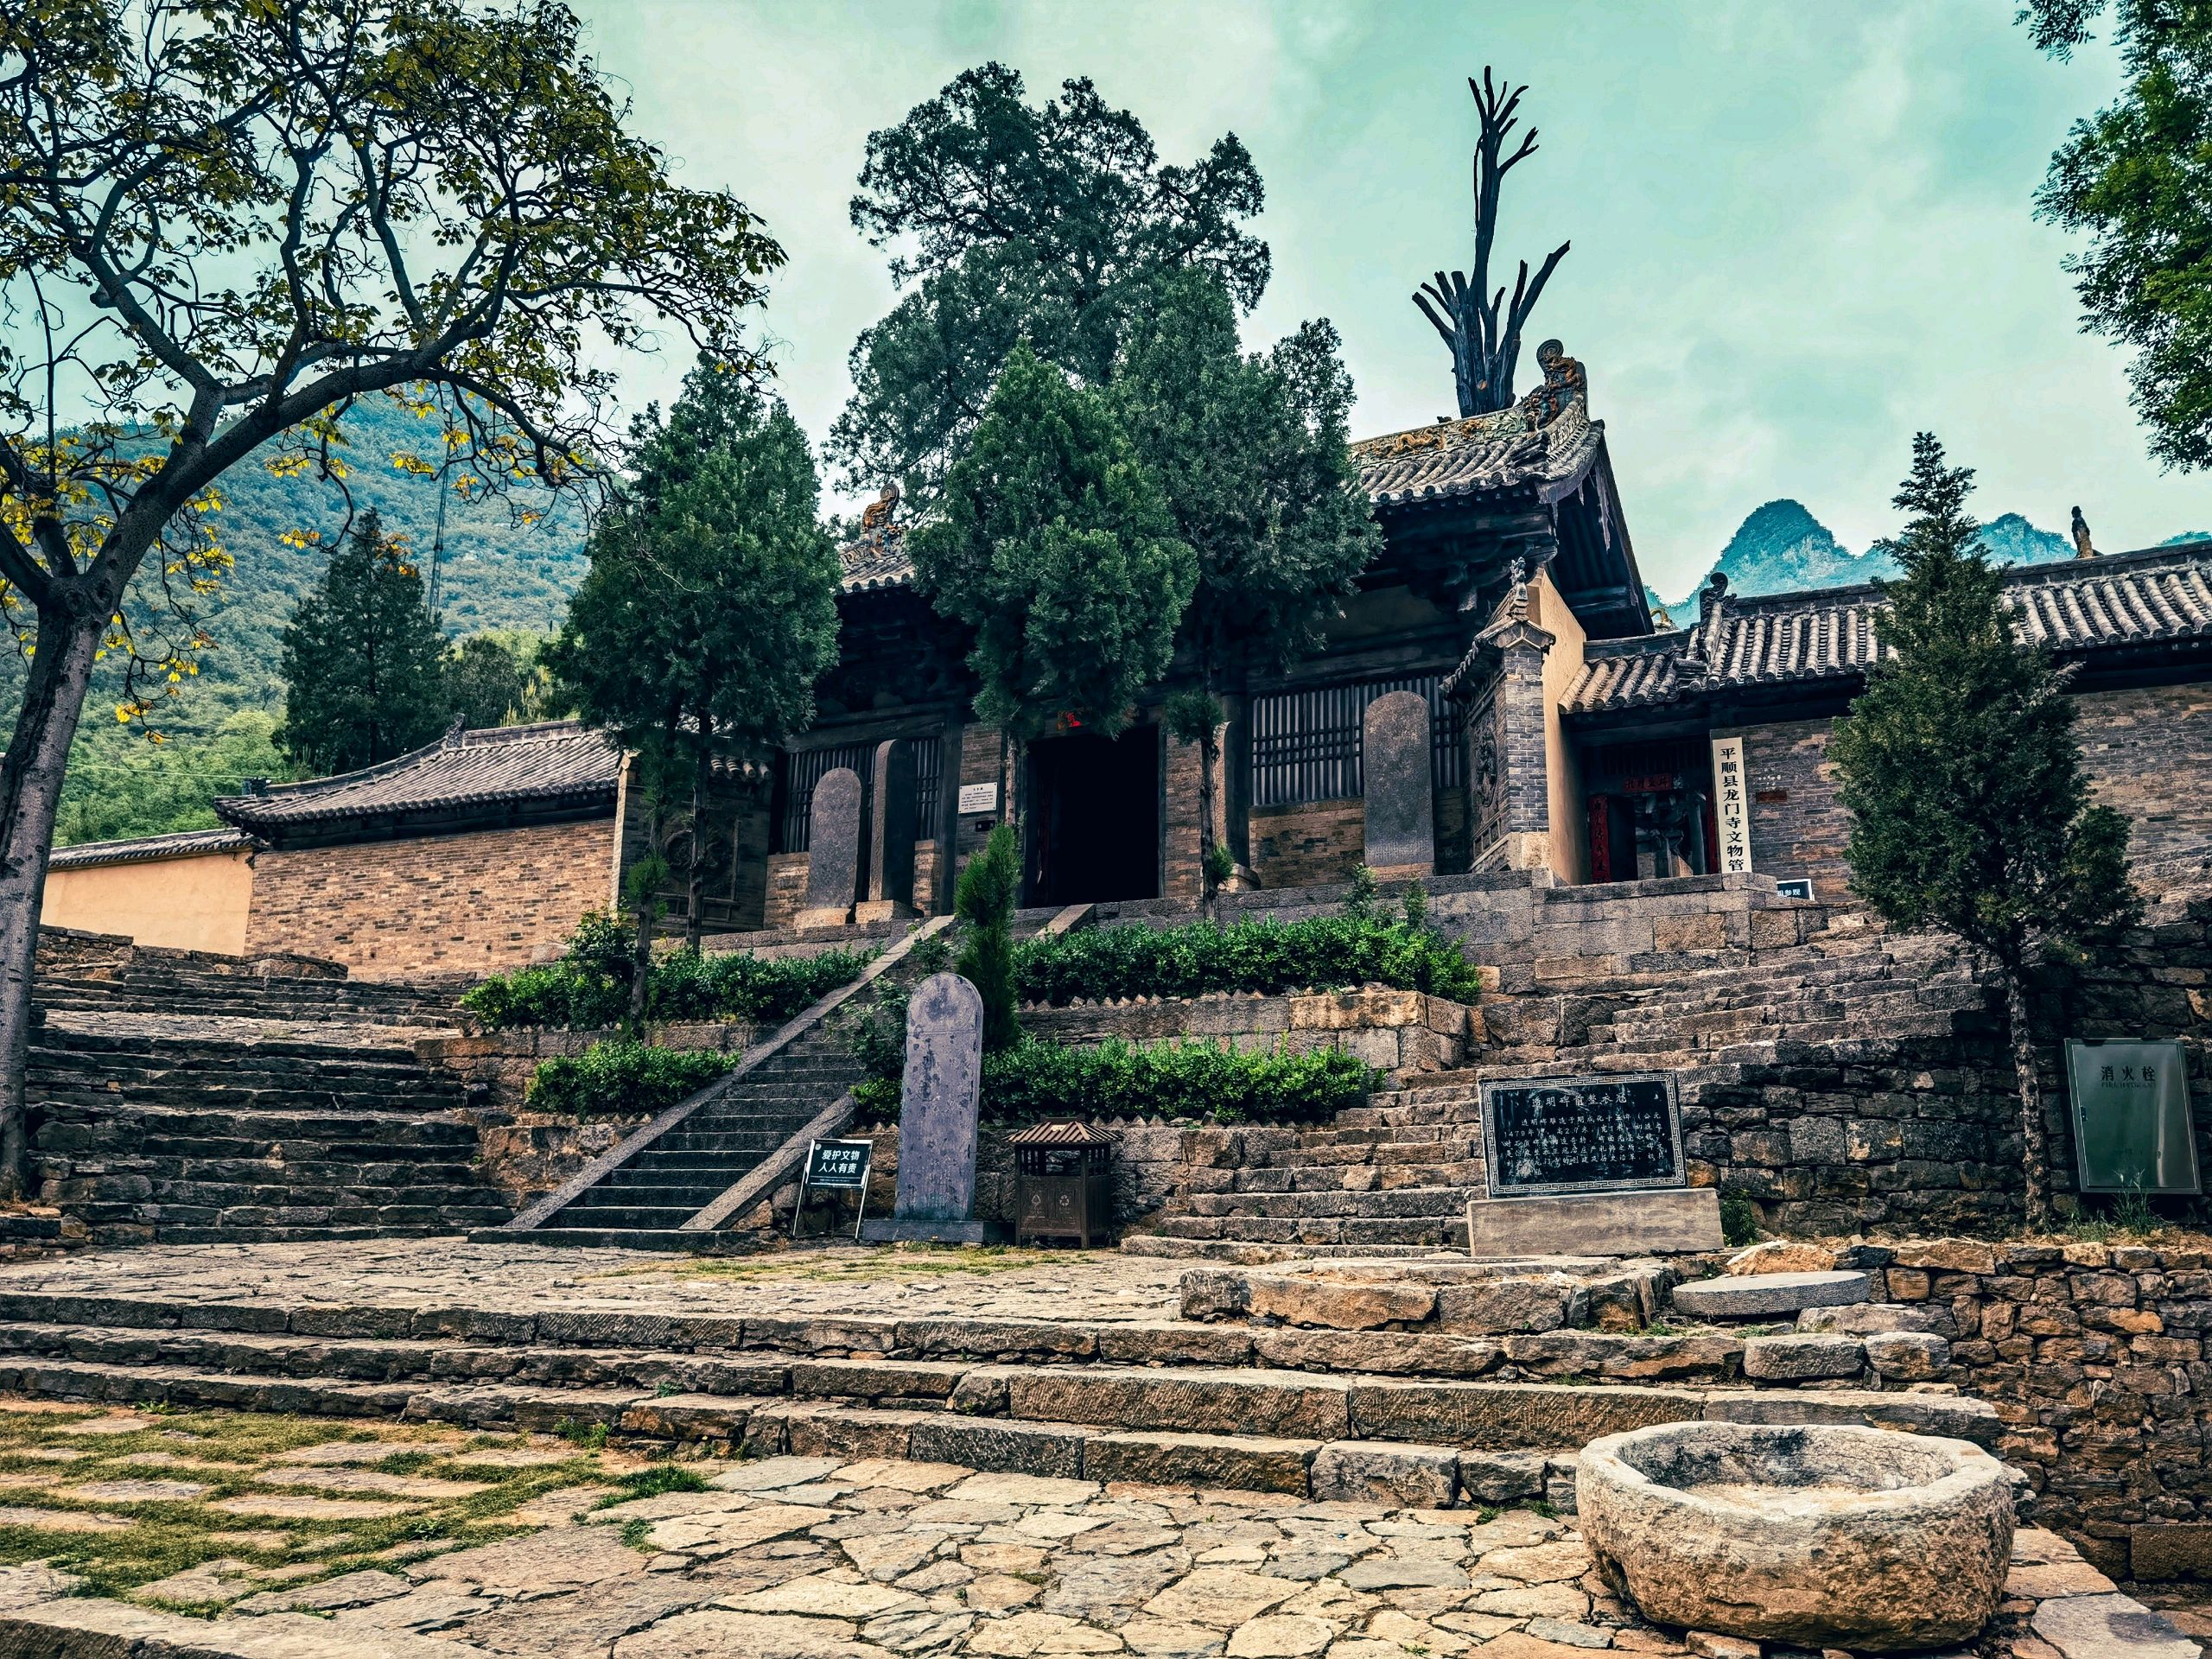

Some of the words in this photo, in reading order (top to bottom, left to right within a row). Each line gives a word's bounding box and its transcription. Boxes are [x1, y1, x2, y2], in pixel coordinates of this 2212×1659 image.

[1719, 747, 1745, 872] 平顺县龙门寺文物管
[2101, 1065, 2155, 1081] 消火栓
[1531, 1092, 1626, 1108] 透明碑前整衣冠
[822, 1150, 860, 1160] 爱护文物
[818, 1162, 857, 1173] 人人有责
